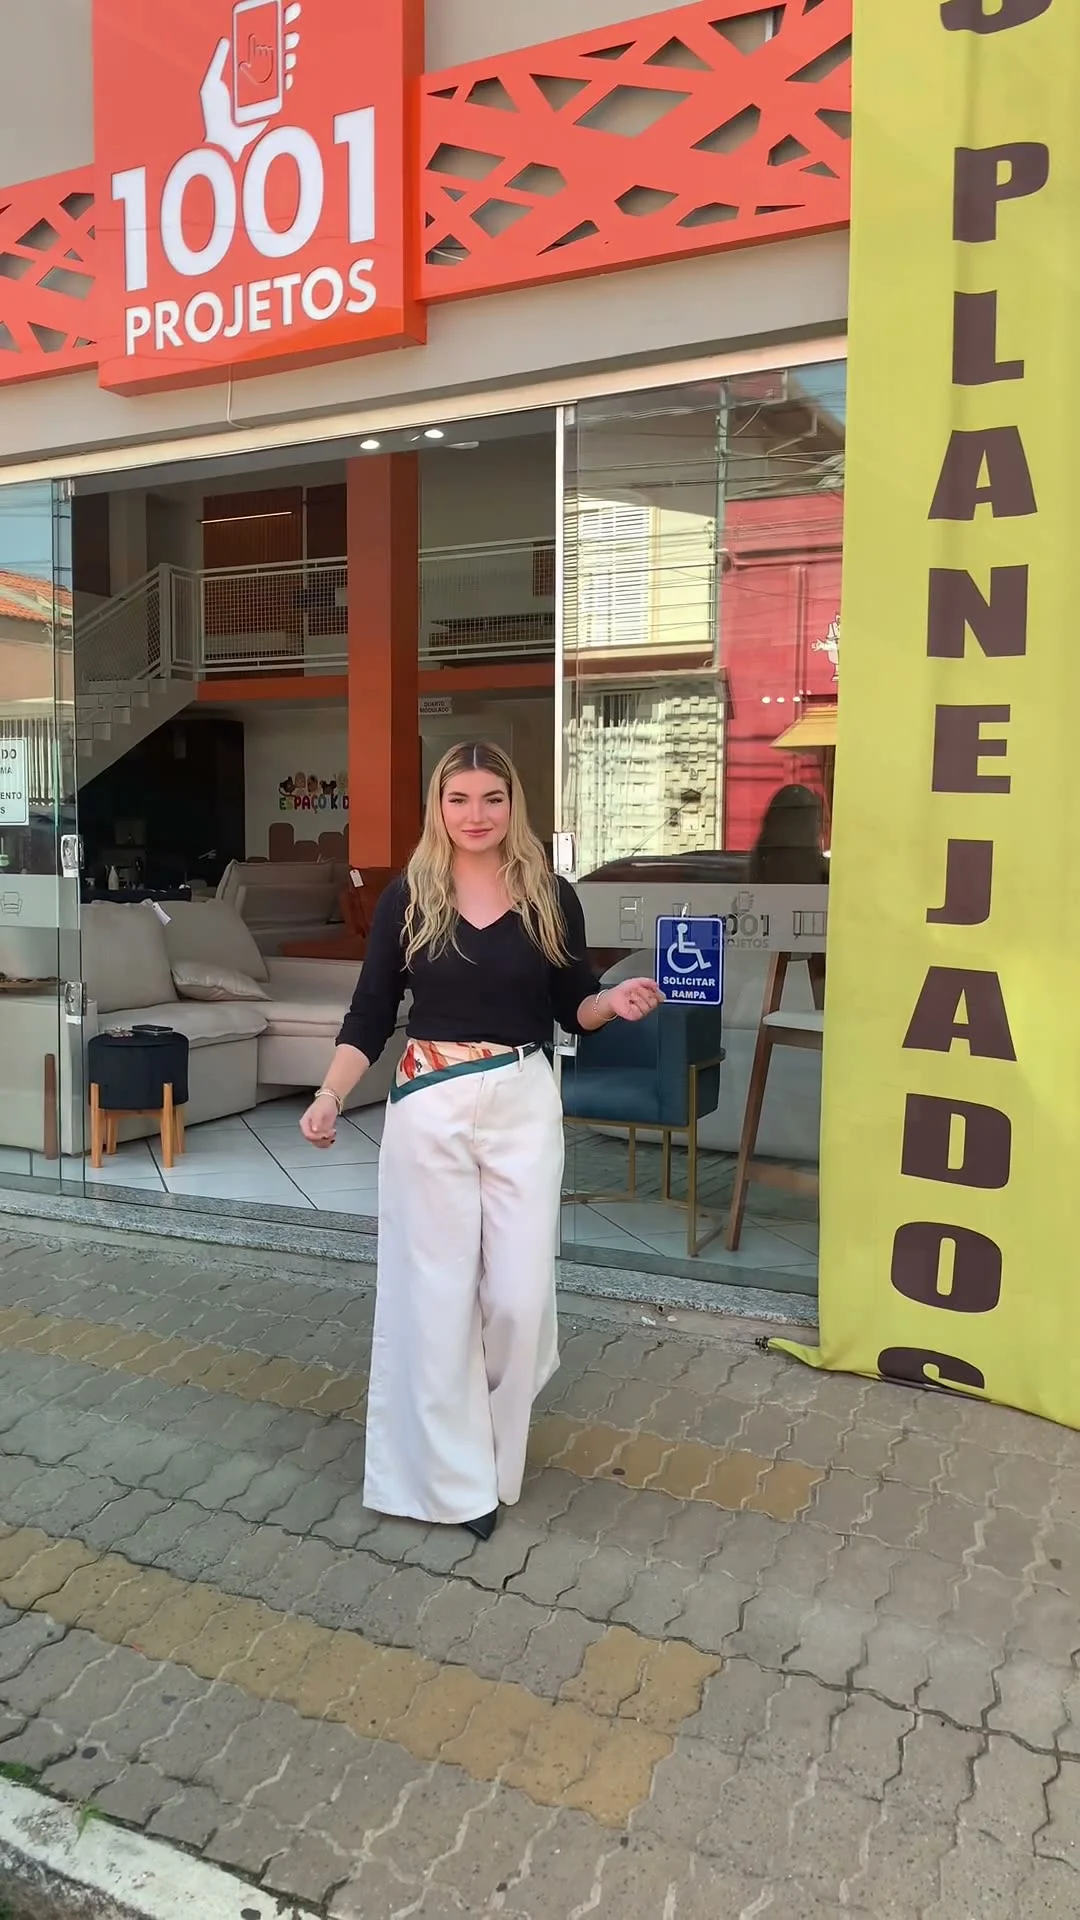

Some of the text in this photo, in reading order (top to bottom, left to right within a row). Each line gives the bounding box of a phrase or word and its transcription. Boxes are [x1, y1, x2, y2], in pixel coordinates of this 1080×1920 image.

[111, 105, 376, 293] 1001
[125, 258, 377, 356] PROJETOS
[279, 794, 327, 814] ESPAÇO
[662, 976, 716, 987] SOLICITAR
[671, 990, 707, 1000] RAMPA
